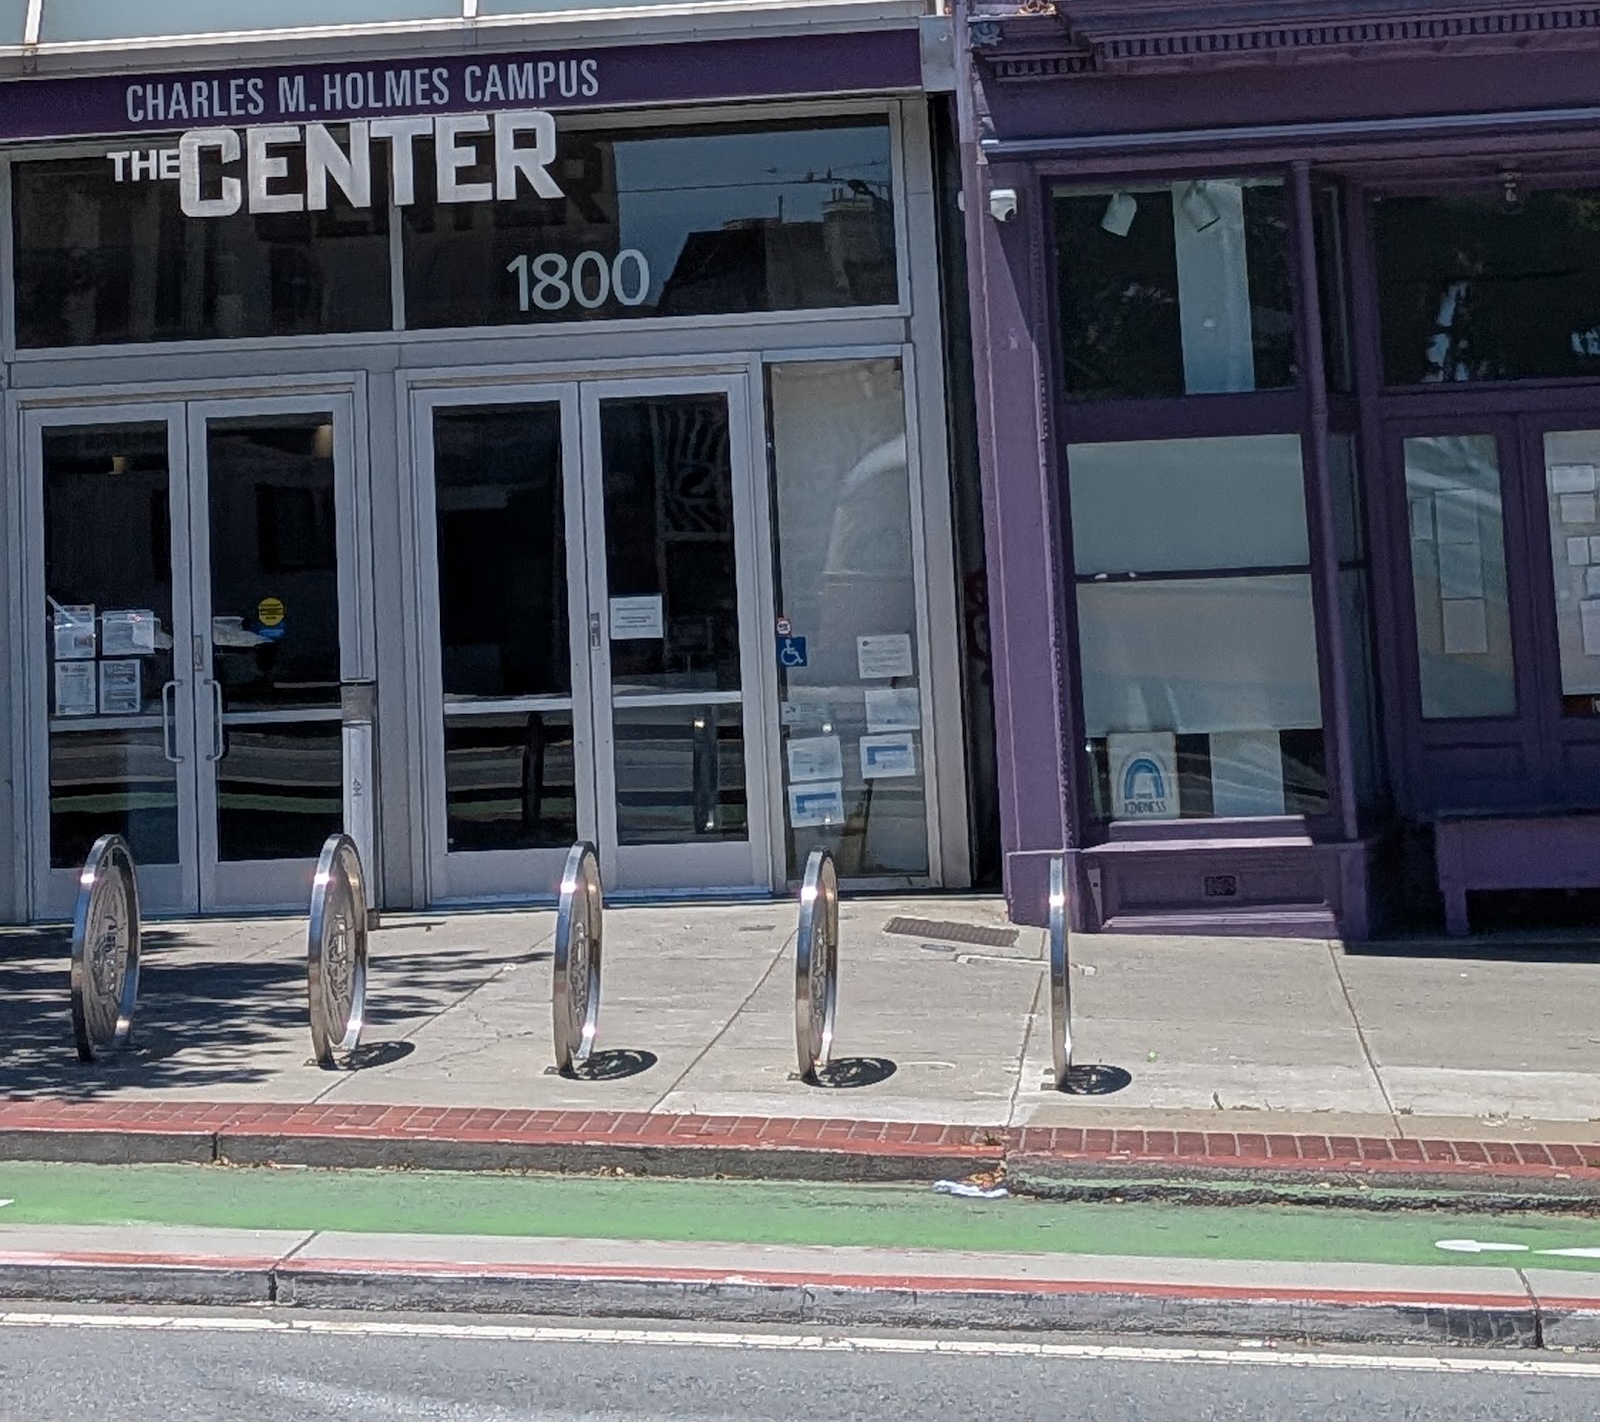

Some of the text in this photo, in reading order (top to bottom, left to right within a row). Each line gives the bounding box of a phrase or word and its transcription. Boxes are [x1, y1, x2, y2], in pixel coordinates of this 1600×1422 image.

[126, 78, 264, 123] CHARLES
[323, 67, 449, 110] HOLMES
[464, 59, 599, 103] CAMPUS
[106, 111, 565, 218] THE CENTER
[506, 249, 650, 312] 1800
